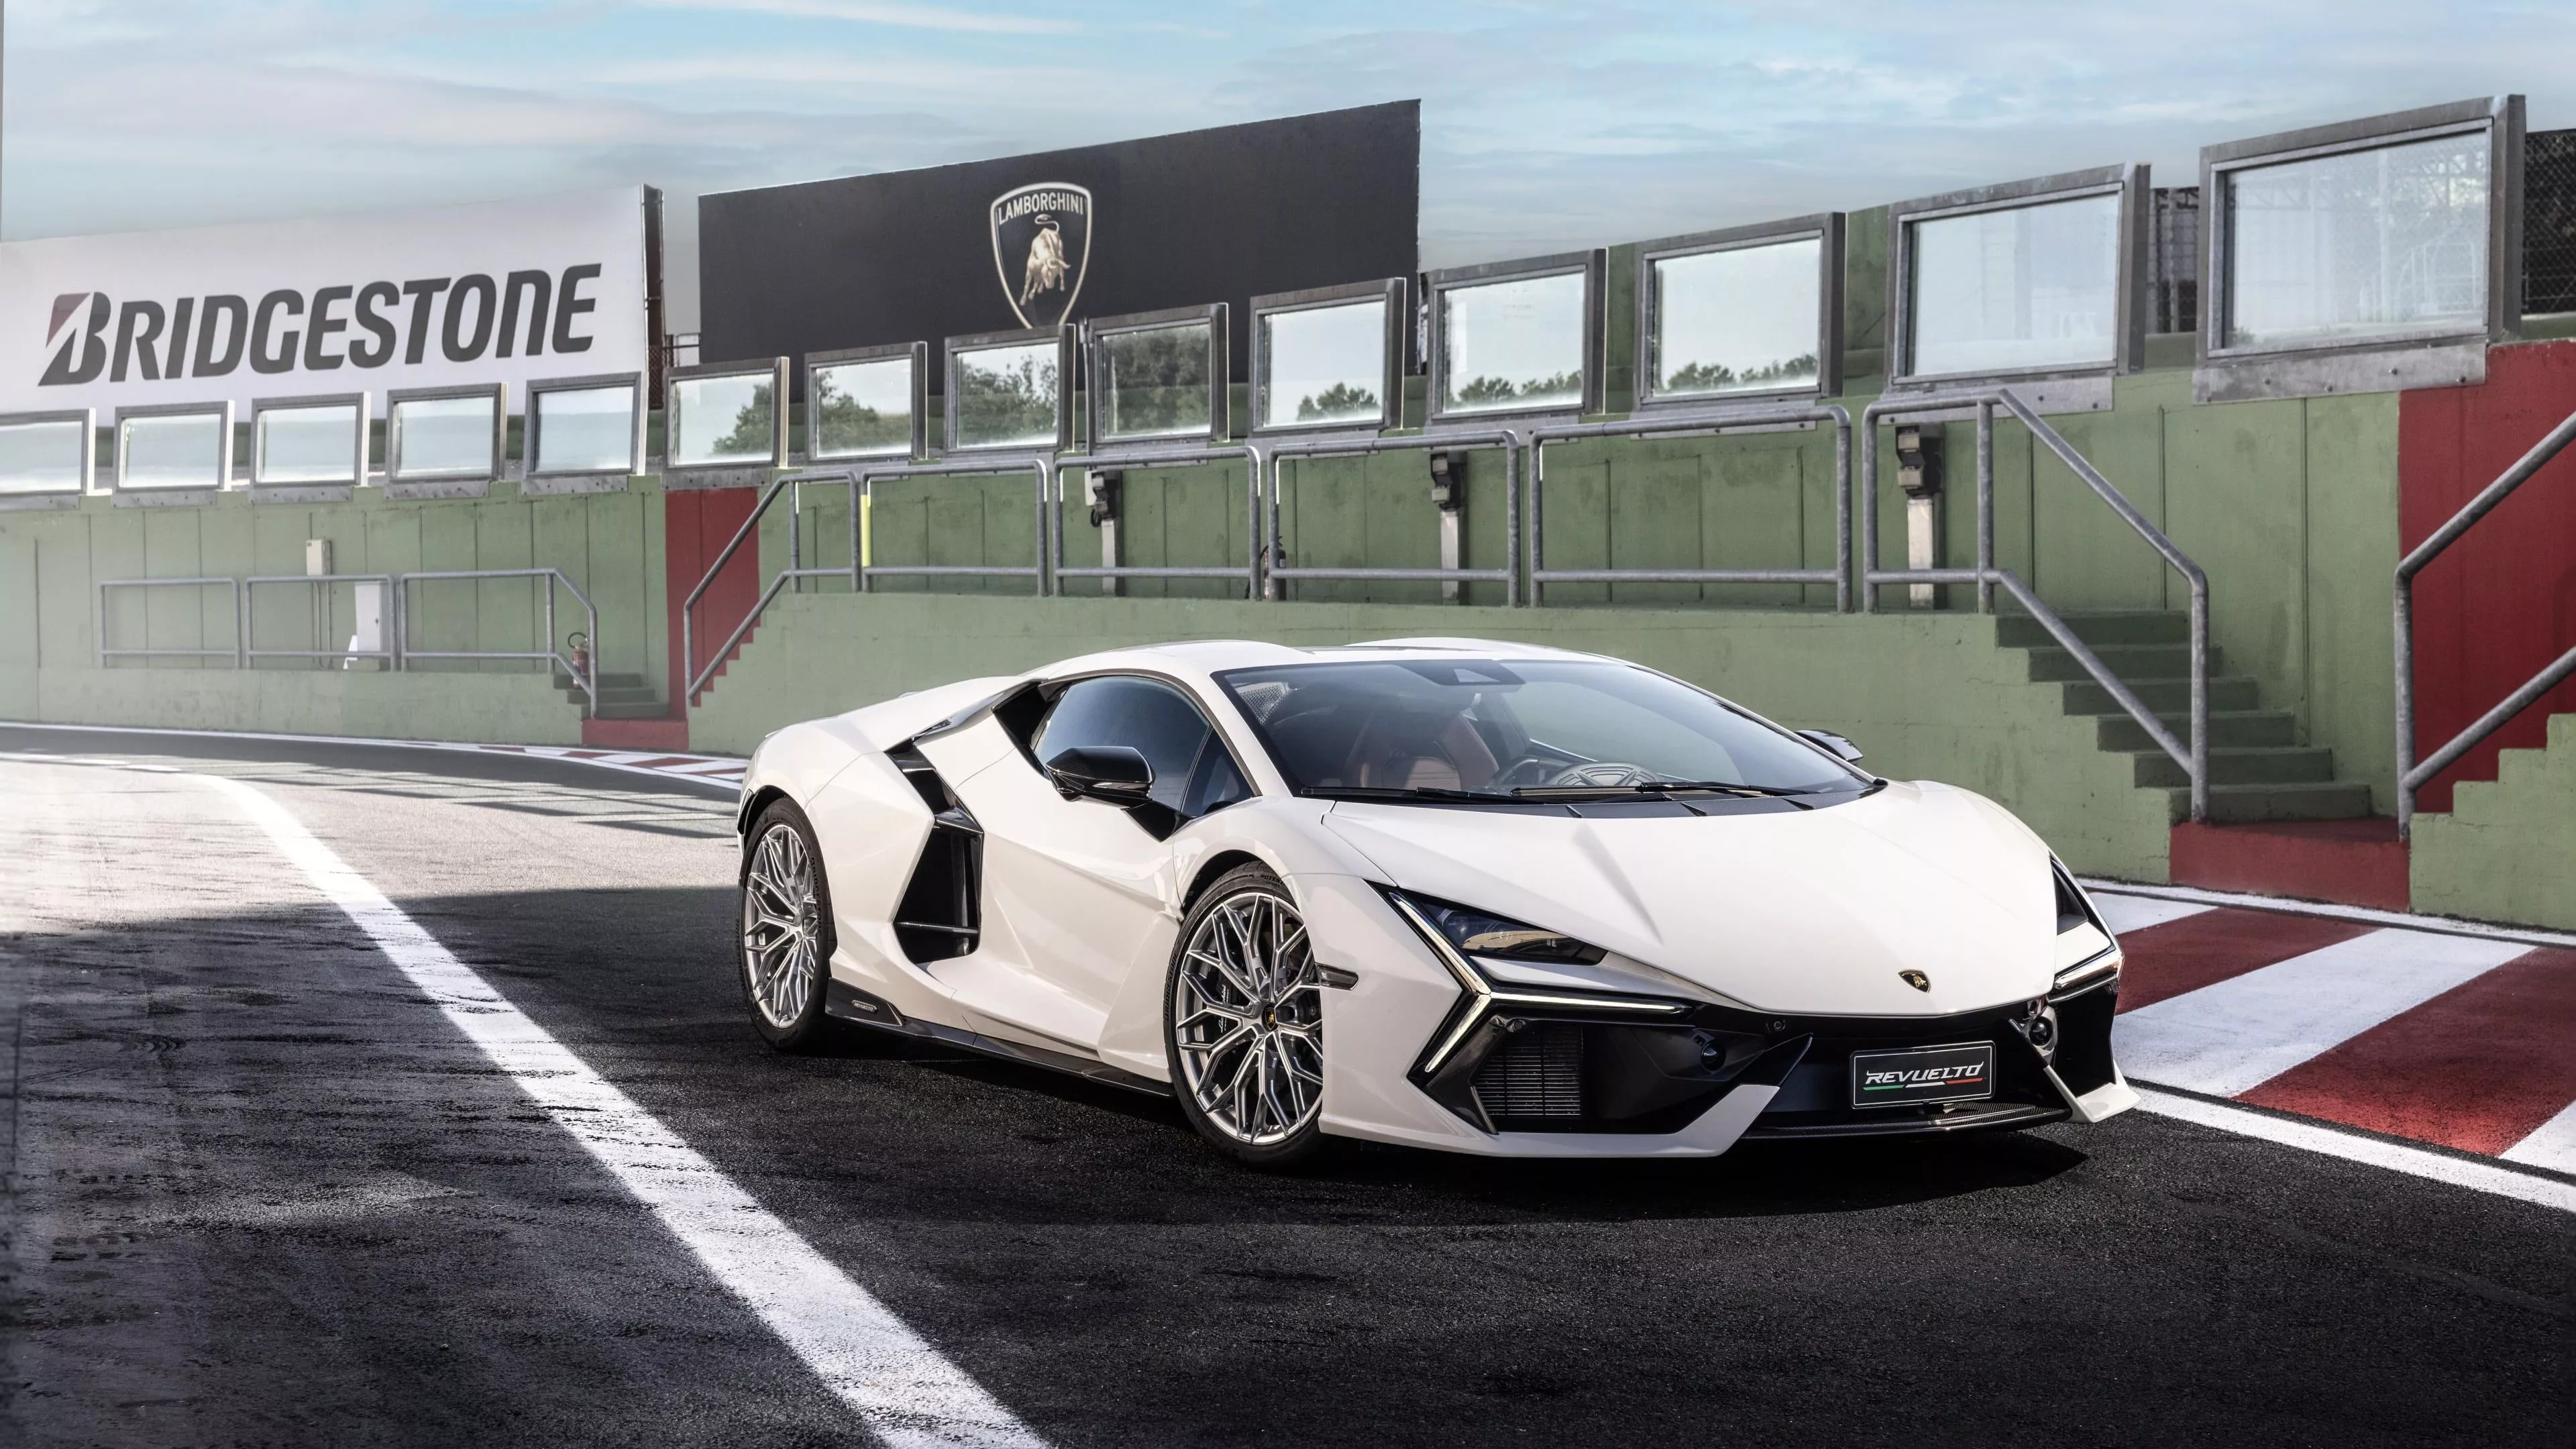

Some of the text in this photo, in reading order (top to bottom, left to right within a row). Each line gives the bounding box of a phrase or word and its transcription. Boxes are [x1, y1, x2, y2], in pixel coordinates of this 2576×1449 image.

[998, 192, 1083, 225] LAMBORGHINI
[38, 262, 601, 386] BRIDGESTONE
[1866, 1061, 1984, 1084] REVUELTO
